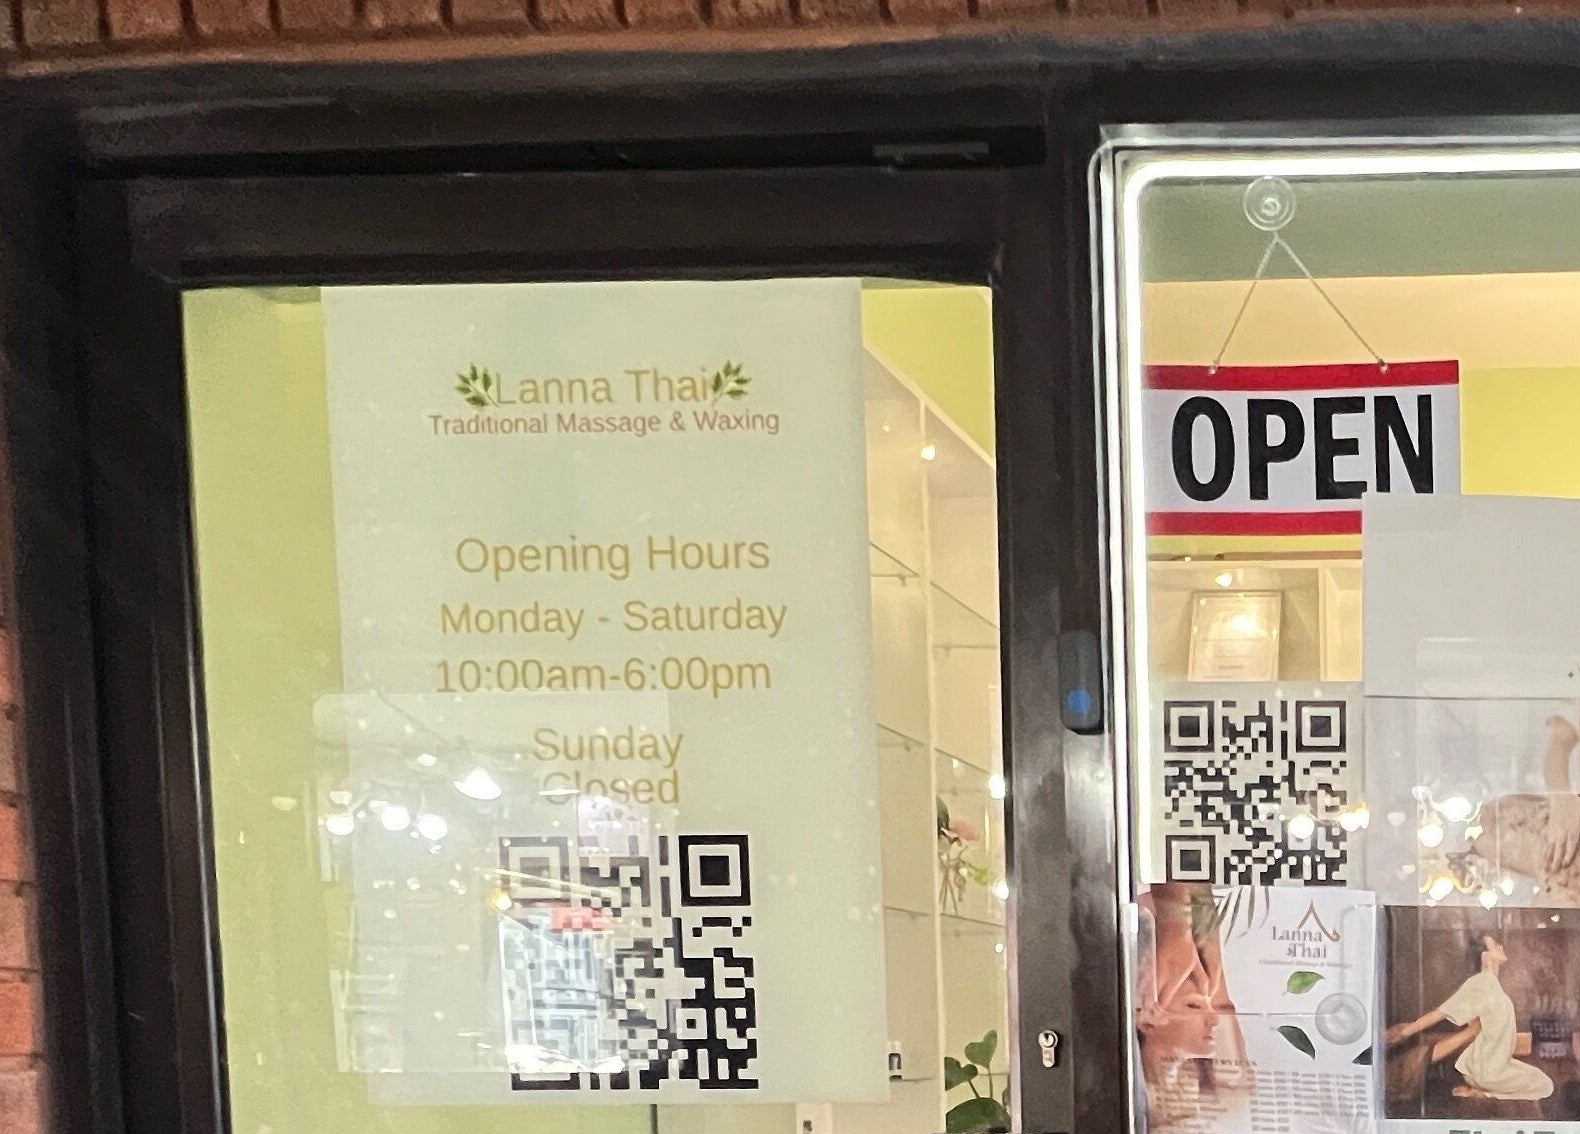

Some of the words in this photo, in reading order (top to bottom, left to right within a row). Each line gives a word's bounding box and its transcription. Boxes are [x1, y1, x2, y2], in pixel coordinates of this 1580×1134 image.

[495, 372, 613, 405] Lanna
[623, 366, 709, 403] Thai
[428, 413, 549, 436] Traditional
[557, 411, 661, 438] Massage
[669, 411, 686, 432] &
[693, 408, 780, 436] Waxing
[1172, 394, 1433, 501] OPEN
[455, 535, 630, 581] Opening
[646, 535, 771, 571] Hours
[440, 600, 585, 641] Monday
[623, 597, 788, 638] Saturday
[436, 656, 772, 699] 10:00am-6:00pm
[532, 725, 685, 768] Sunday
[543, 769, 680, 805] Closed
[1272, 926, 1322, 942] Lanna
[1289, 942, 1327, 958] Thai
